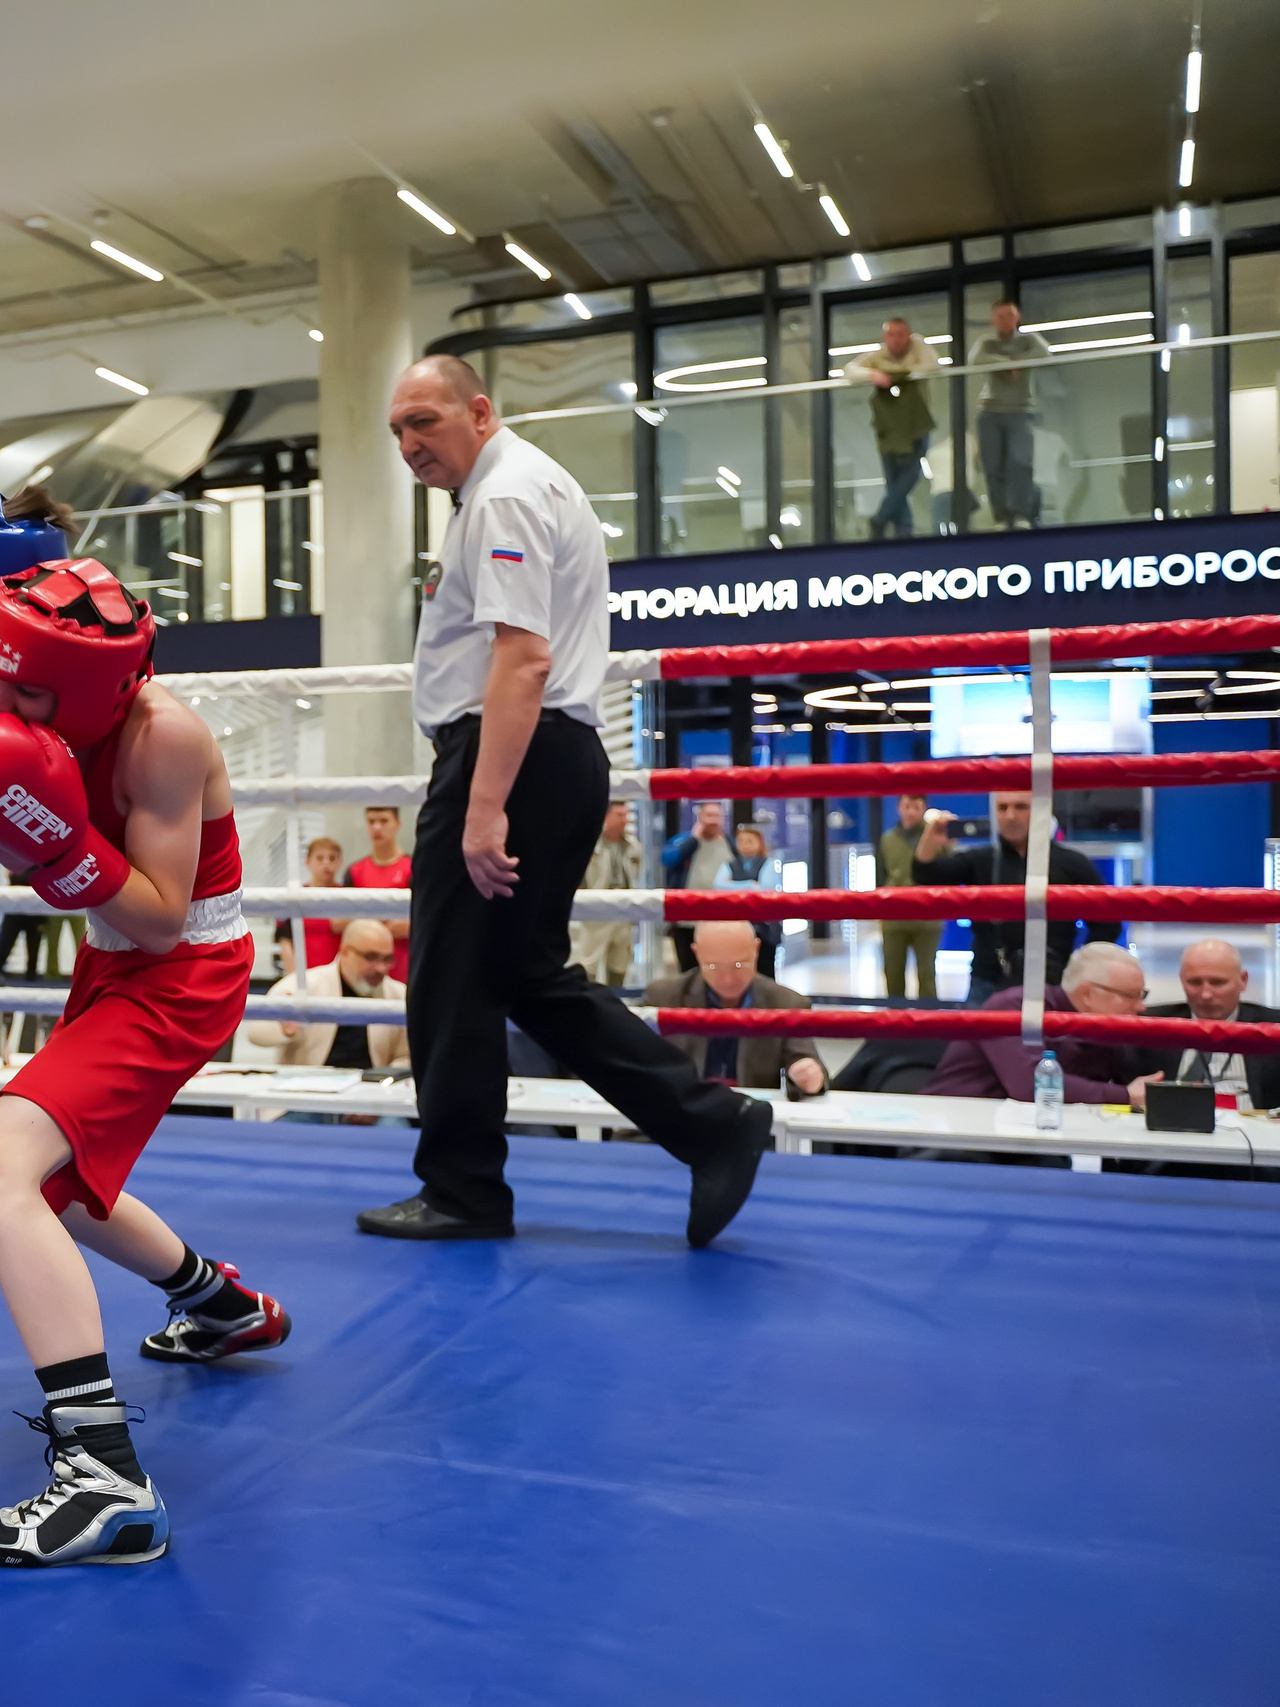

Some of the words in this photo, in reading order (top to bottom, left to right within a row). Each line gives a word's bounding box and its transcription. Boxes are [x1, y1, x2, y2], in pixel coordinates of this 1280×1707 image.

[808, 564, 1032, 608] МОРСКОГО
[7, 784, 73, 840] GREEN
[53, 853, 96, 890] GREEN
[60, 870, 100, 898] HILL
